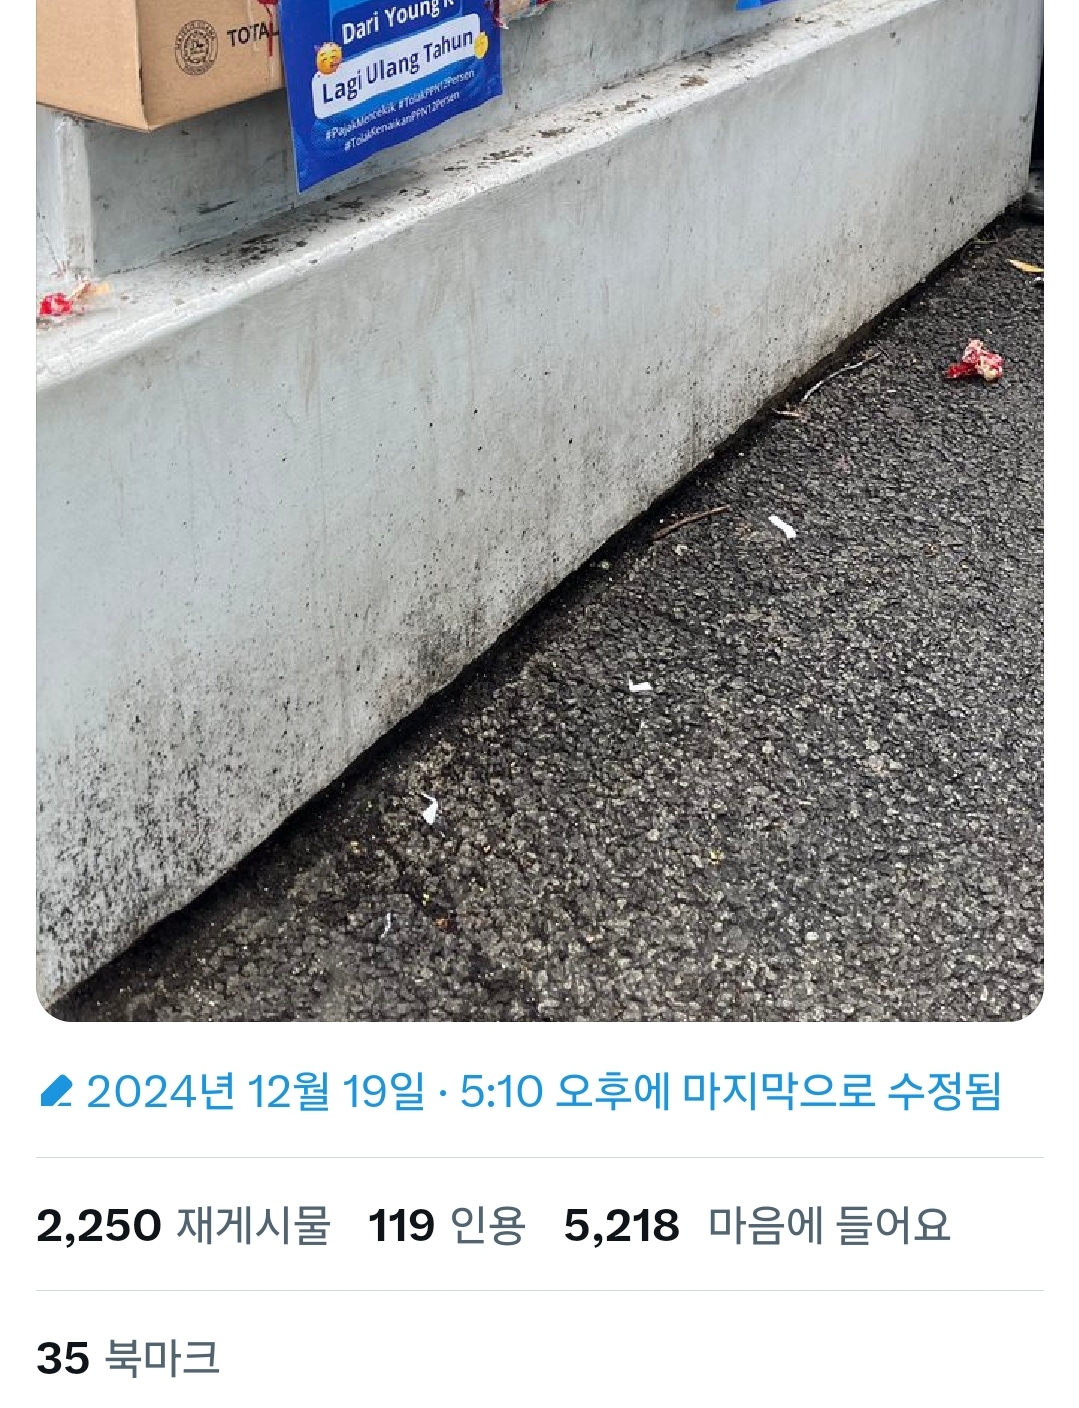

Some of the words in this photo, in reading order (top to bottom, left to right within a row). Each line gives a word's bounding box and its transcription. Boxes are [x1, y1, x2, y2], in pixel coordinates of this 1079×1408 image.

[341, 10, 379, 45] Dari
[322, 70, 363, 104] Lagi
[366, 52, 419, 85] Ulang
[423, 30, 473, 63] Tahun
